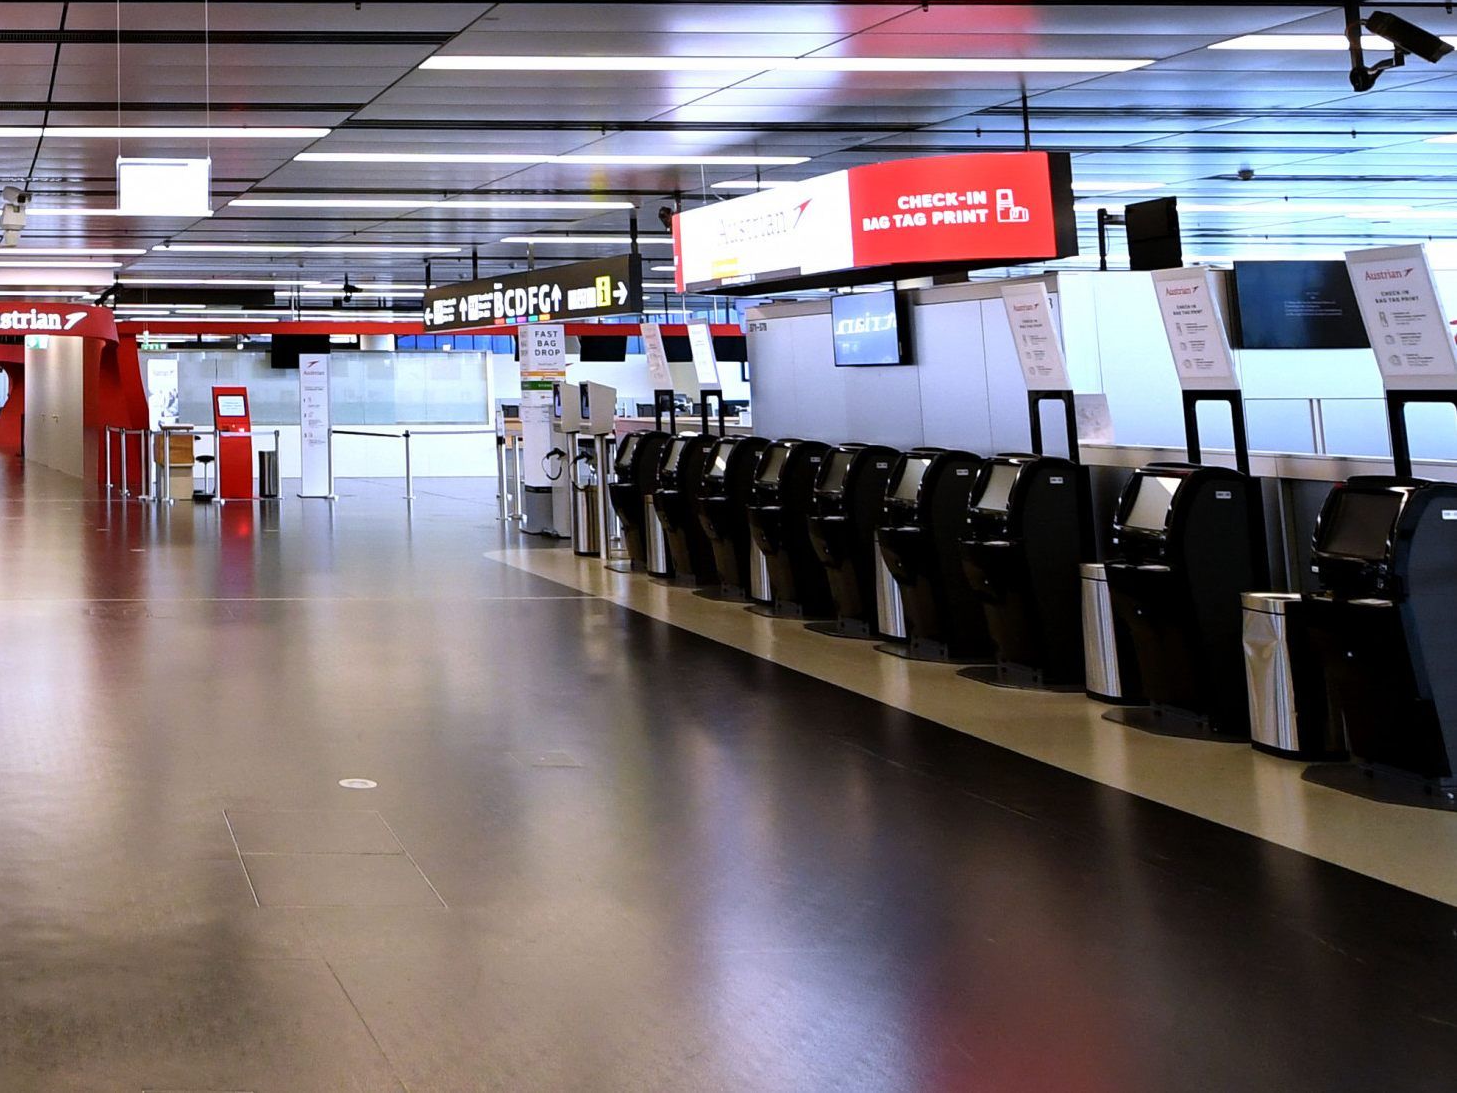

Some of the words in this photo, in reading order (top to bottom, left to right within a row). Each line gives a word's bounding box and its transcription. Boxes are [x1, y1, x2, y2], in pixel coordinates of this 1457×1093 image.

[897, 191, 987, 210] CHECK-IN
[862, 216, 891, 231] BAG
[893, 213, 927, 228] TAG
[932, 209, 989, 225] PRINT
[1365, 270, 1402, 281] Austrian
[534, 349, 560, 357] DROP
